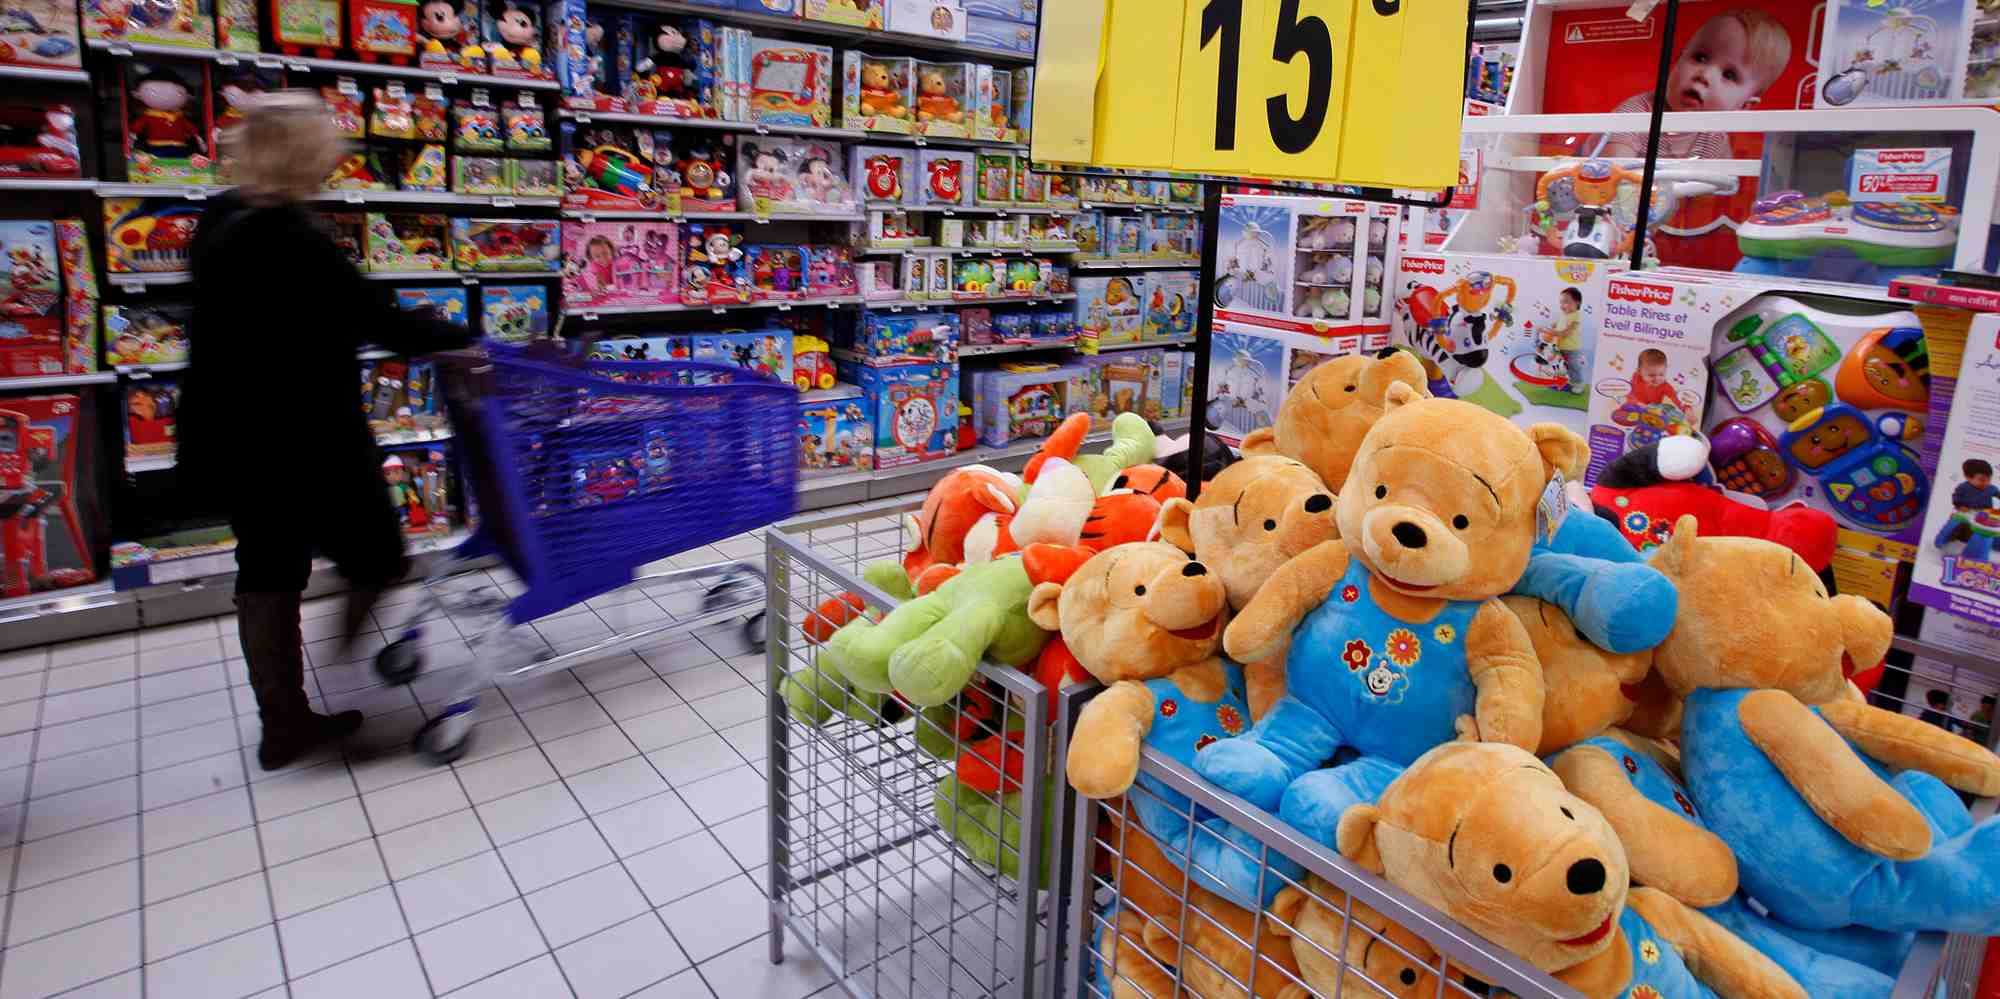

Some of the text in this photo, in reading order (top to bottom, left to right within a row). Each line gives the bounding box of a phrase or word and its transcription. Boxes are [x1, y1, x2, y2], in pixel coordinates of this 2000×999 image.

[1199, 0, 1332, 154] 15
[1606, 303, 1688, 324] Table Rires et
[1604, 318, 1684, 339] Eveil Bilingue
